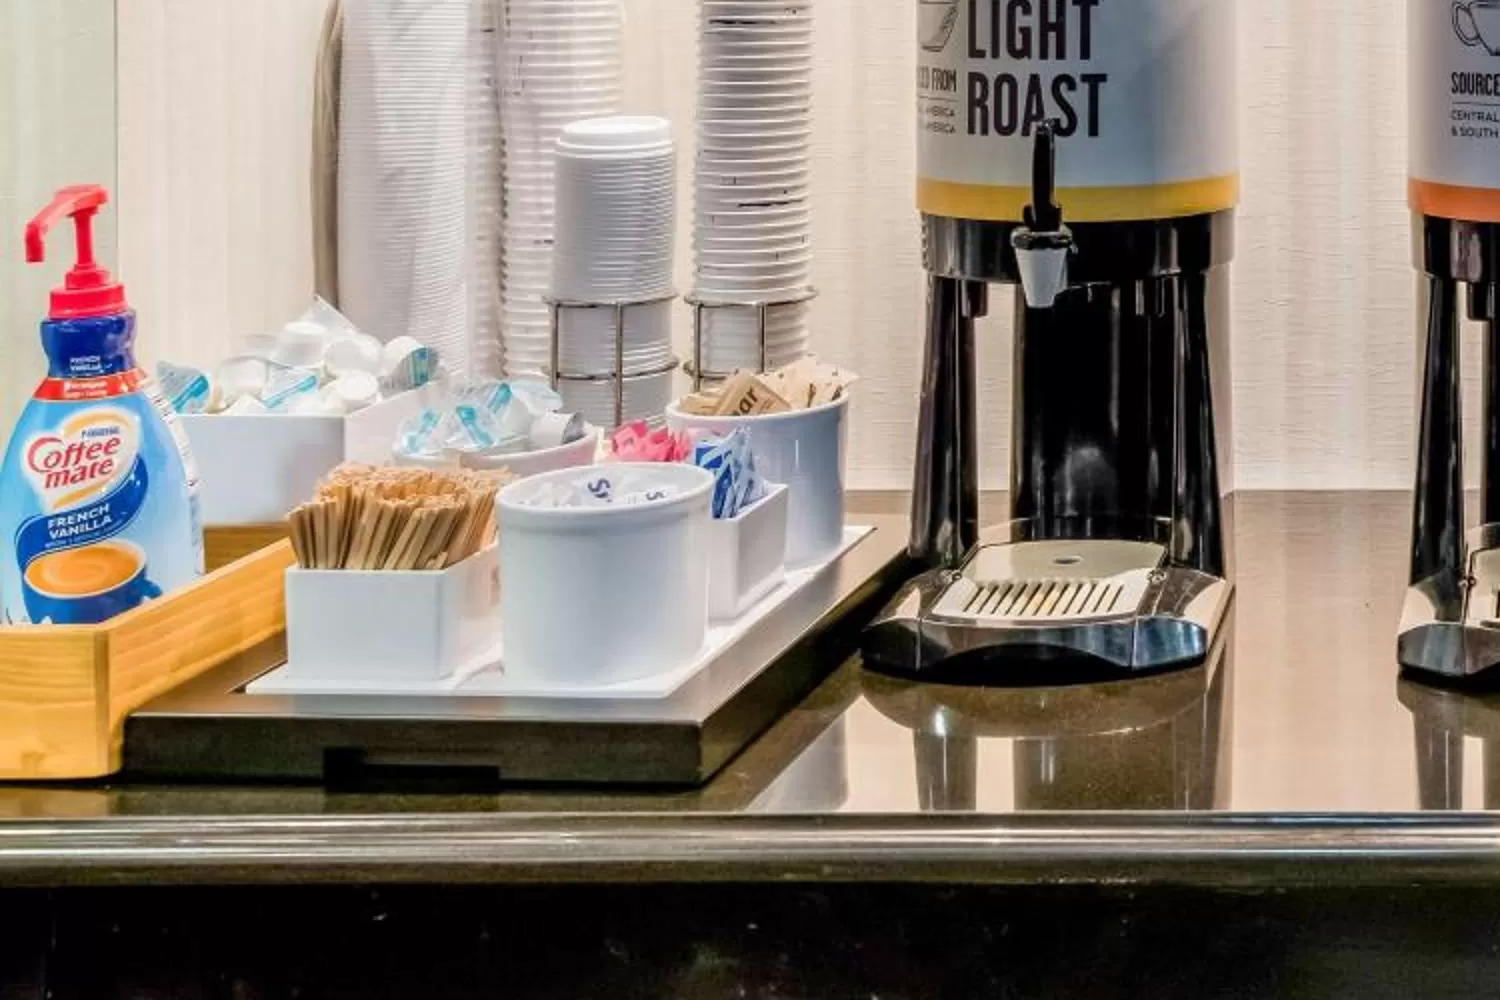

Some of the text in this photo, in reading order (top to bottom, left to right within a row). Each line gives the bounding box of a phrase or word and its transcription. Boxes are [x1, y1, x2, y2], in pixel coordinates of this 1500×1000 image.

[967, 71, 1109, 138] ROAST
[1451, 109, 1500, 123] CENTRAL
[1460, 127, 1500, 140] SOUTH
[28, 436, 121, 474] Coffee
[44, 456, 115, 489] mate
[48, 503, 110, 529] FRENCH
[48, 514, 113, 540] VANILLA
